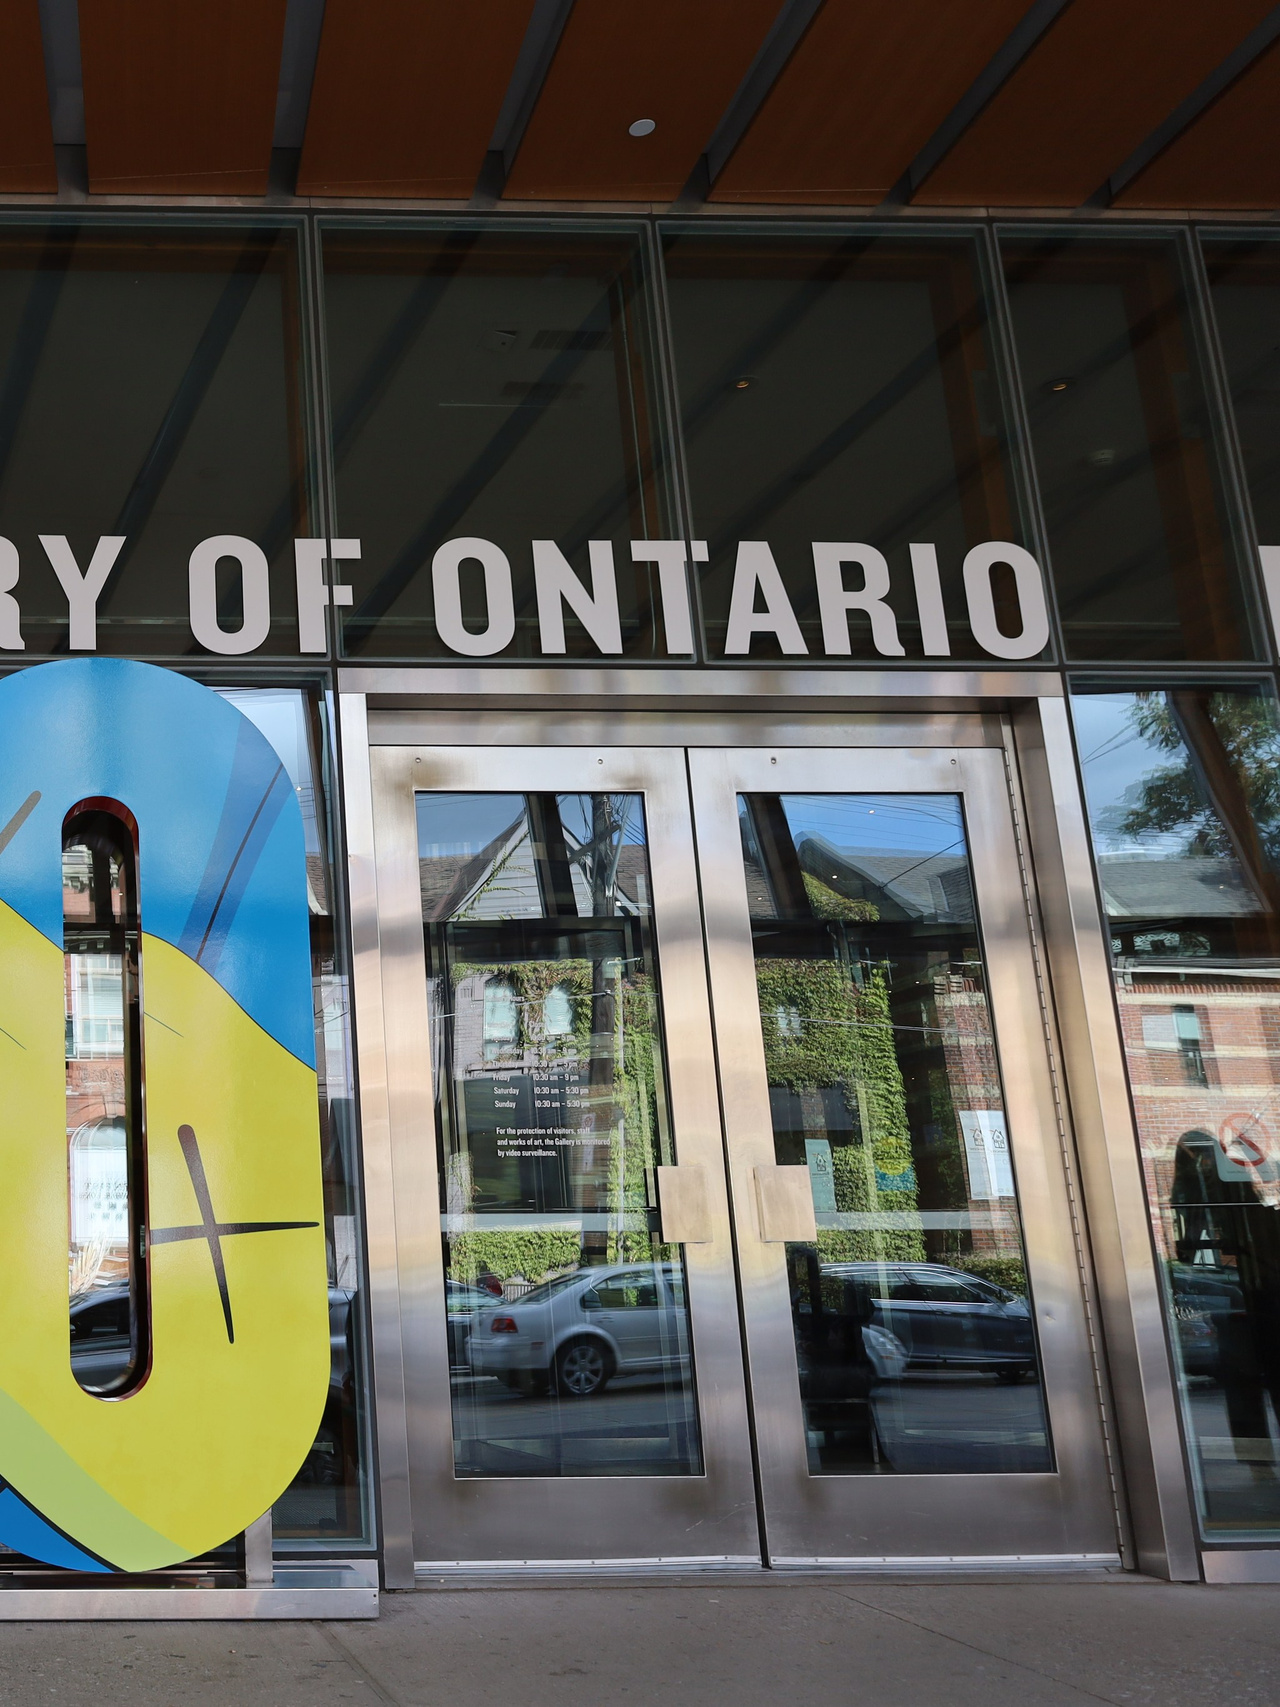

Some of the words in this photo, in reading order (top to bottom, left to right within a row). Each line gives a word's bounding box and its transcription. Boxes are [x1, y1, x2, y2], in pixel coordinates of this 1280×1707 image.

[188, 534, 362, 656] OF
[431, 536, 1051, 660] ONTARIO
[493, 1074, 510, 1082] Friday
[532, 1073, 548, 1081] 10:30
[493, 1087, 519, 1095] Saturday
[534, 1086, 549, 1094] 10:30
[494, 1101, 516, 1109] Sunday
[516, 1127, 546, 1136] protection
[497, 1138, 508, 1146] and
[508, 1138, 526, 1146] works
[533, 1138, 544, 1147] art,
[544, 1138, 555, 1146] the
[554, 1138, 575, 1147] Gallery
[497, 1150, 505, 1158] by
[505, 1149, 522, 1157] video
[521, 1149, 558, 1158] surveillance.
